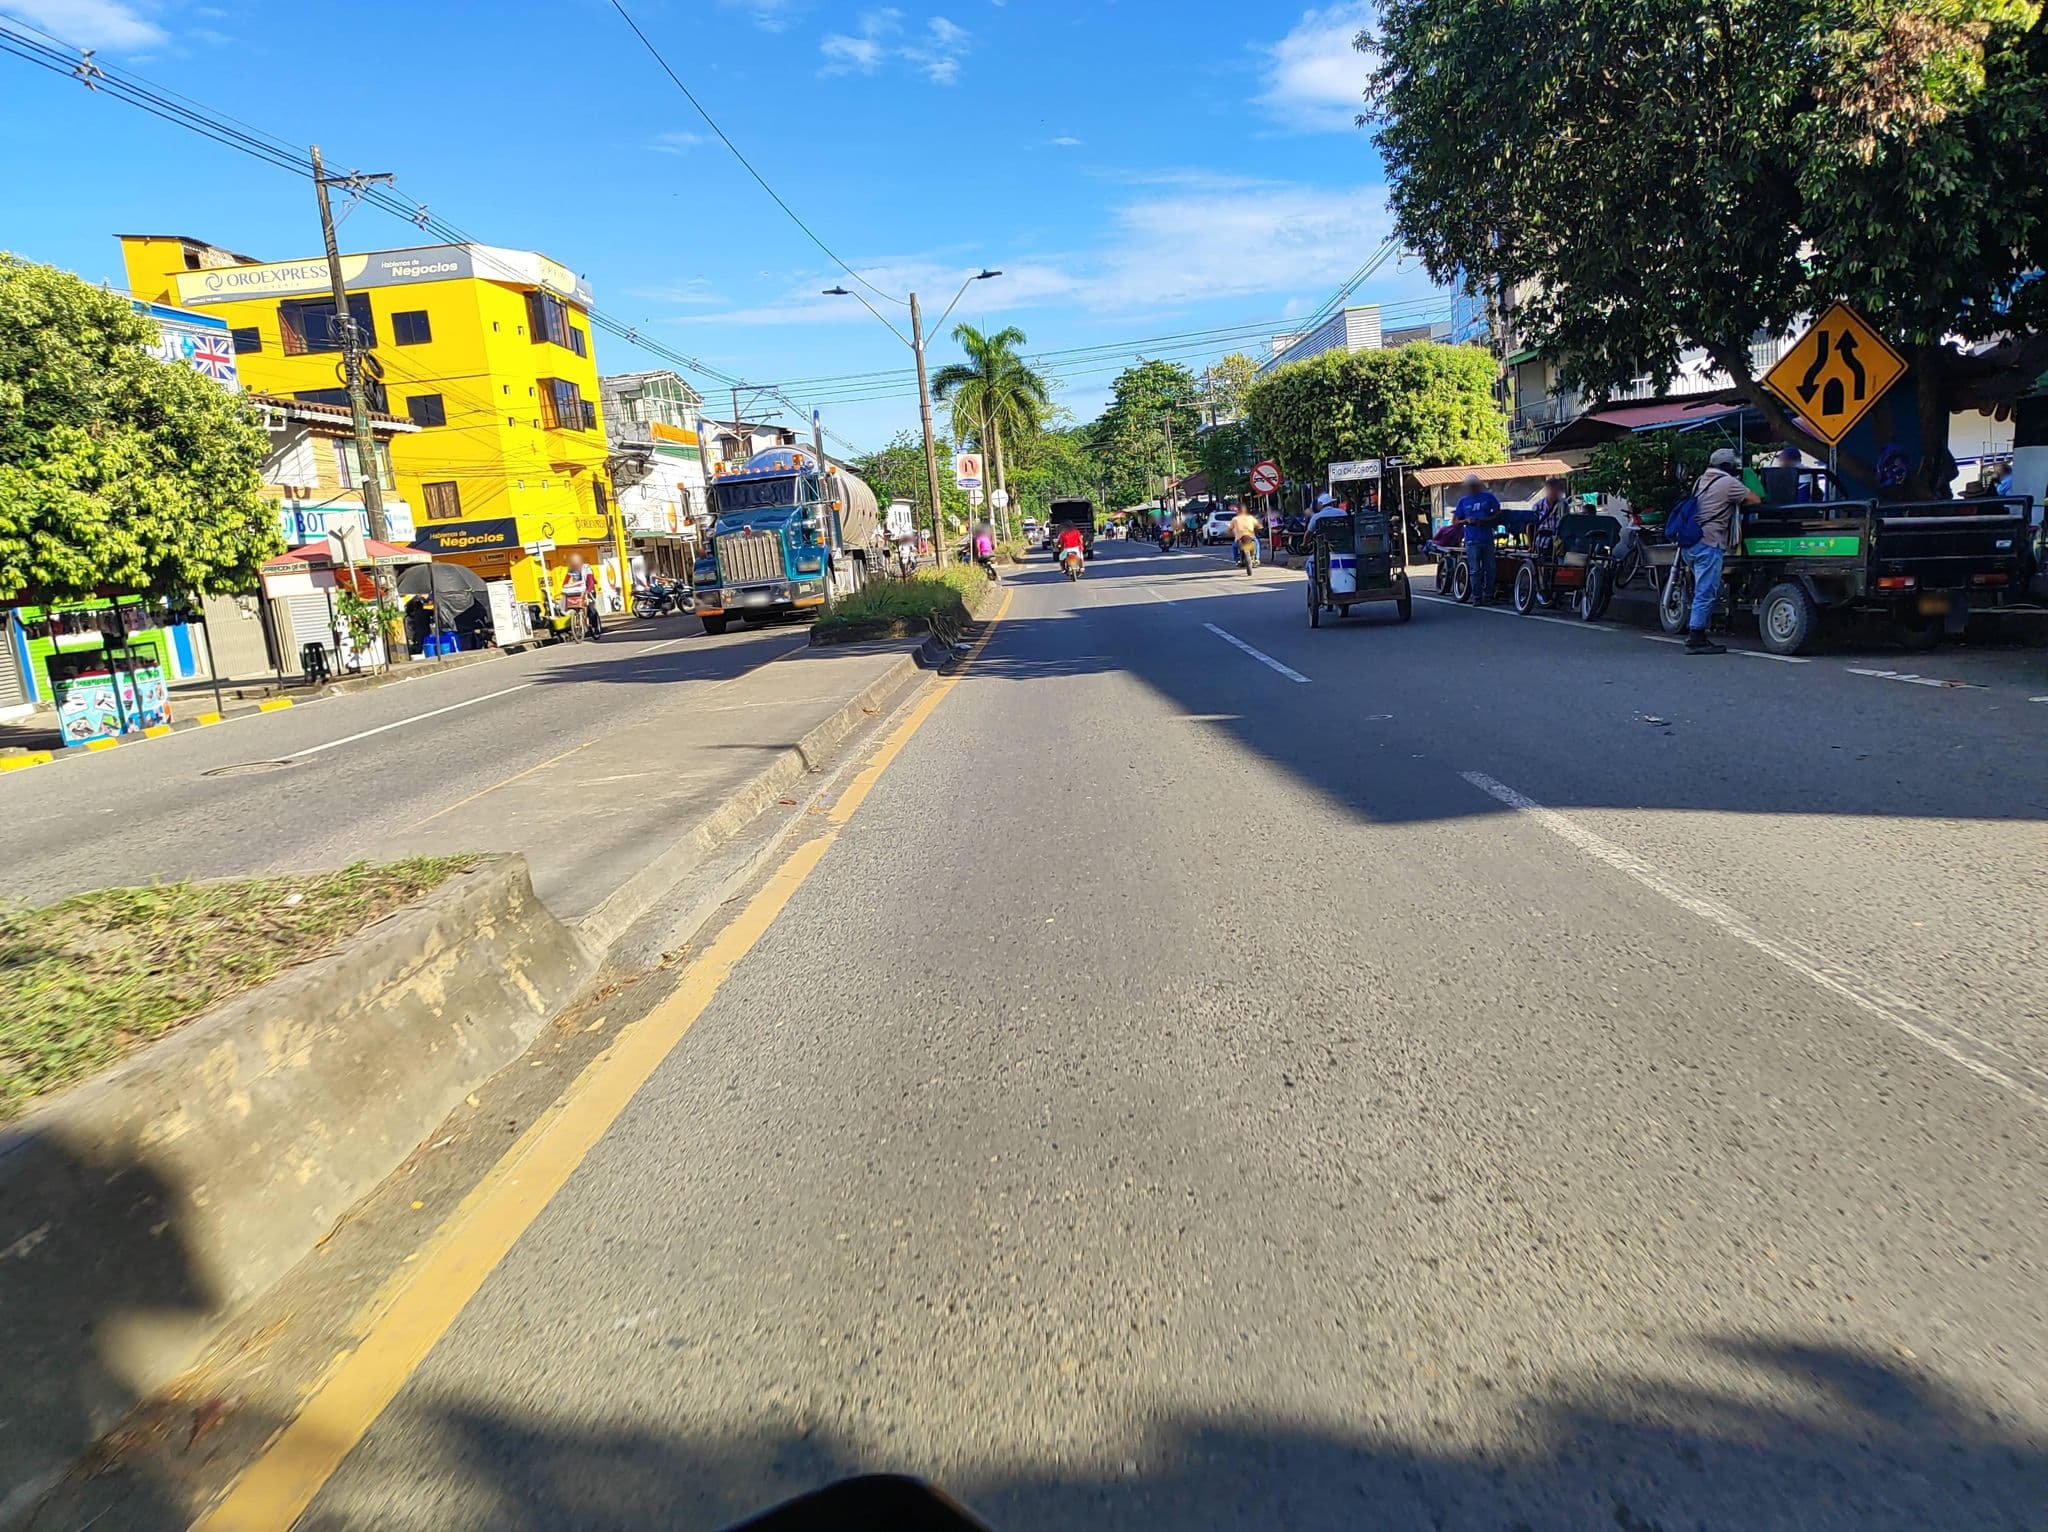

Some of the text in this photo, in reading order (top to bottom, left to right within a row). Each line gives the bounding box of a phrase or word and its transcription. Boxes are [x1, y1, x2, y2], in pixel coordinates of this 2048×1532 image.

[381, 258, 420, 270] Hablemos de
[392, 262, 458, 277] Negocios
[227, 264, 328, 287] OROEXPRESS
[440, 533, 505, 547] Negocios
[459, 530, 467, 538] de
